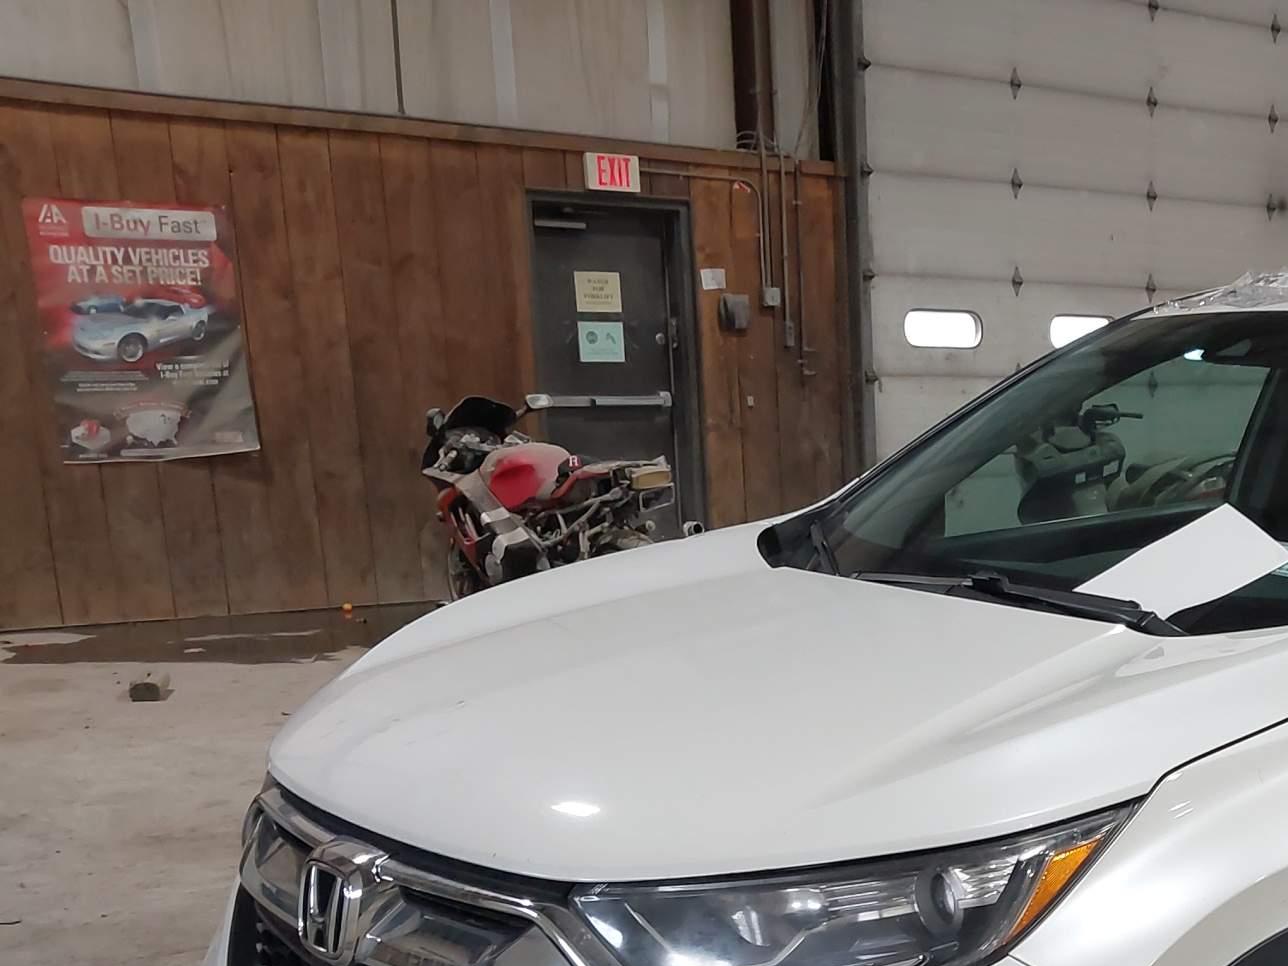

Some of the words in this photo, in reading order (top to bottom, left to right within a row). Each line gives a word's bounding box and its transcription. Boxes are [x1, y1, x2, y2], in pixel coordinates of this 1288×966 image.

[596, 155, 631, 188] EXIT
[94, 212, 151, 237] I-Buy
[158, 215, 202, 234] Fast
[49, 244, 125, 266] QUALITY
[128, 246, 210, 268] VEHICLES
[67, 265, 92, 284] AT
[95, 265, 109, 284] A
[112, 265, 143, 285] SET
[147, 267, 202, 286] PRICE!
